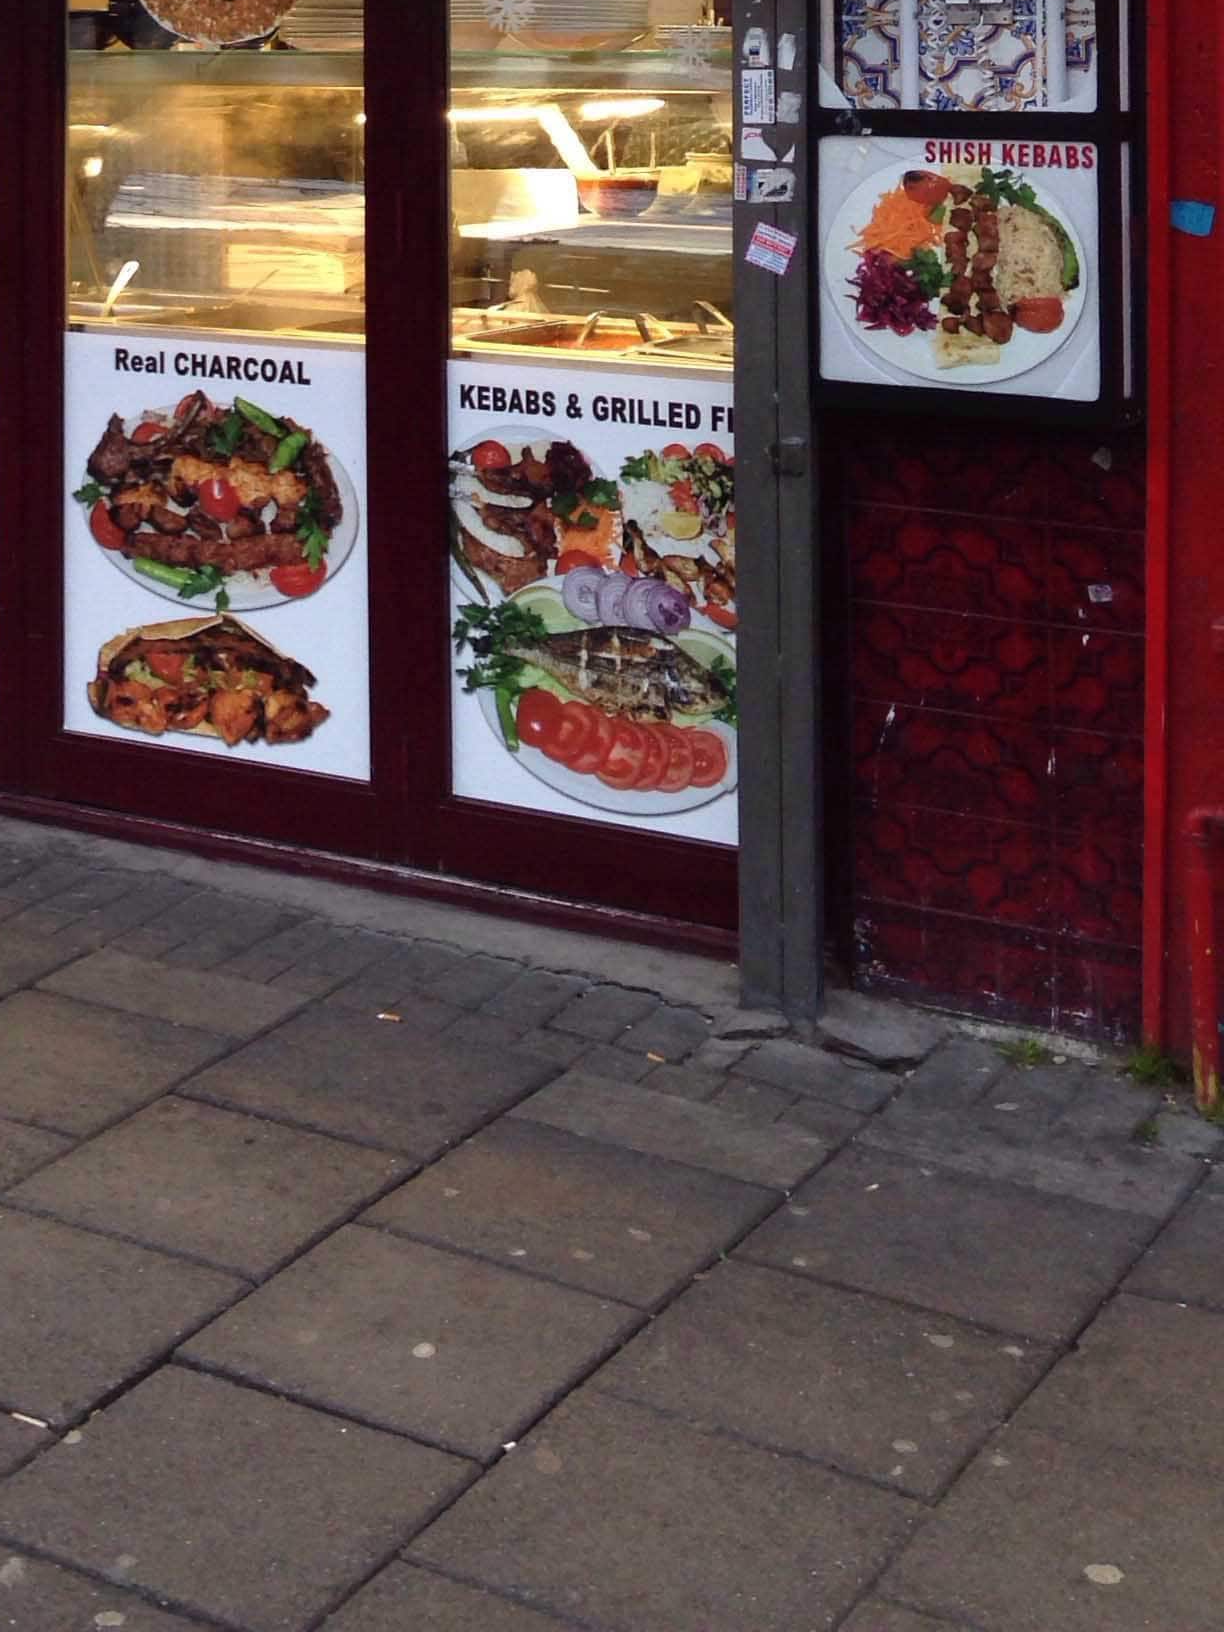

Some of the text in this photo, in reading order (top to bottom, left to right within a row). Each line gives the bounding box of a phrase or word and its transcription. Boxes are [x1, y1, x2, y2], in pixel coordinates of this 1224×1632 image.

[924, 140, 1094, 168] SHISH KEBABS
[114, 348, 311, 385] Real CHARCOAL
[460, 384, 557, 417] KEBABS
[566, 393, 583, 419] &
[592, 395, 702, 430] GRILLED
